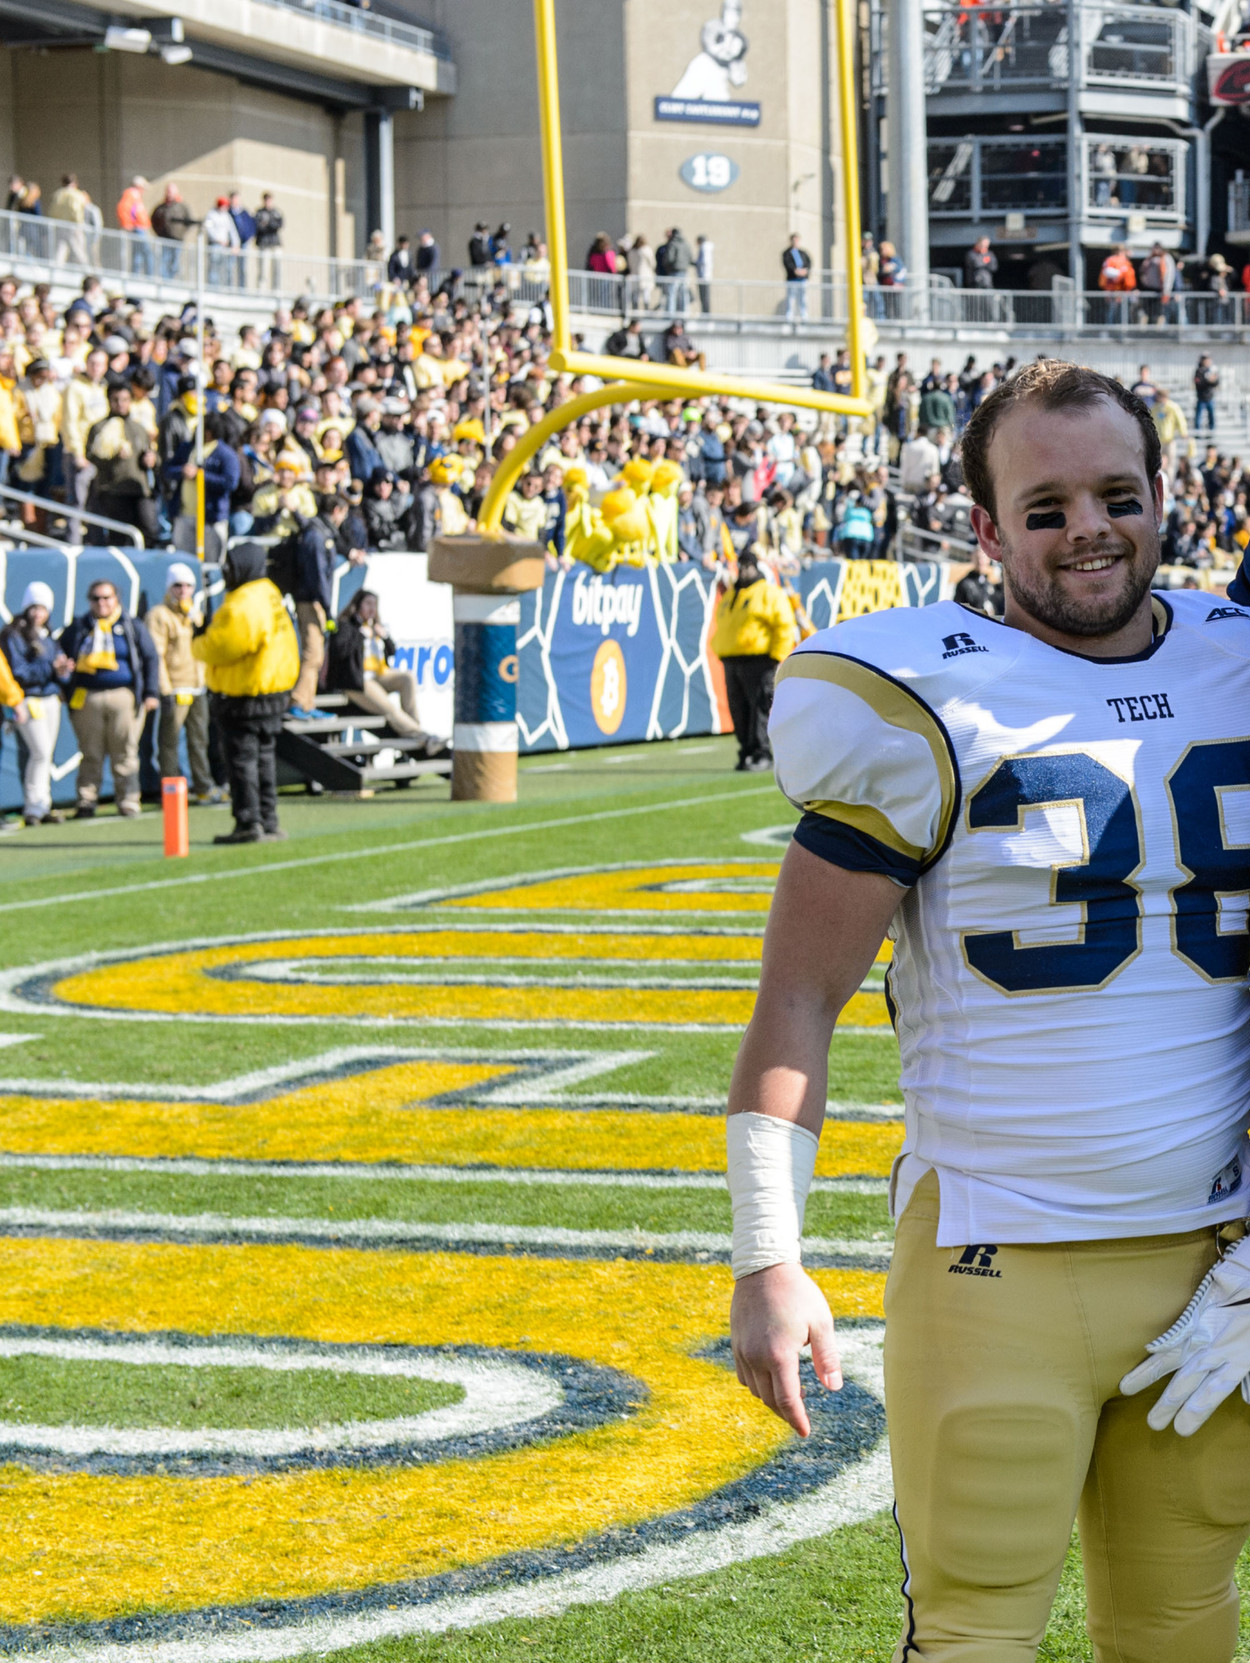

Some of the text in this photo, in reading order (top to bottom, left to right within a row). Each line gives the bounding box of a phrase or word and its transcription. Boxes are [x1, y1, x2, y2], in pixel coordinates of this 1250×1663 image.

[692, 155, 730, 187] 19
[572, 571, 643, 637] bitpay
[942, 645, 989, 660] RUSSELL
[1106, 693, 1174, 723] TECH
[948, 1264, 1003, 1278] RUSSELL
